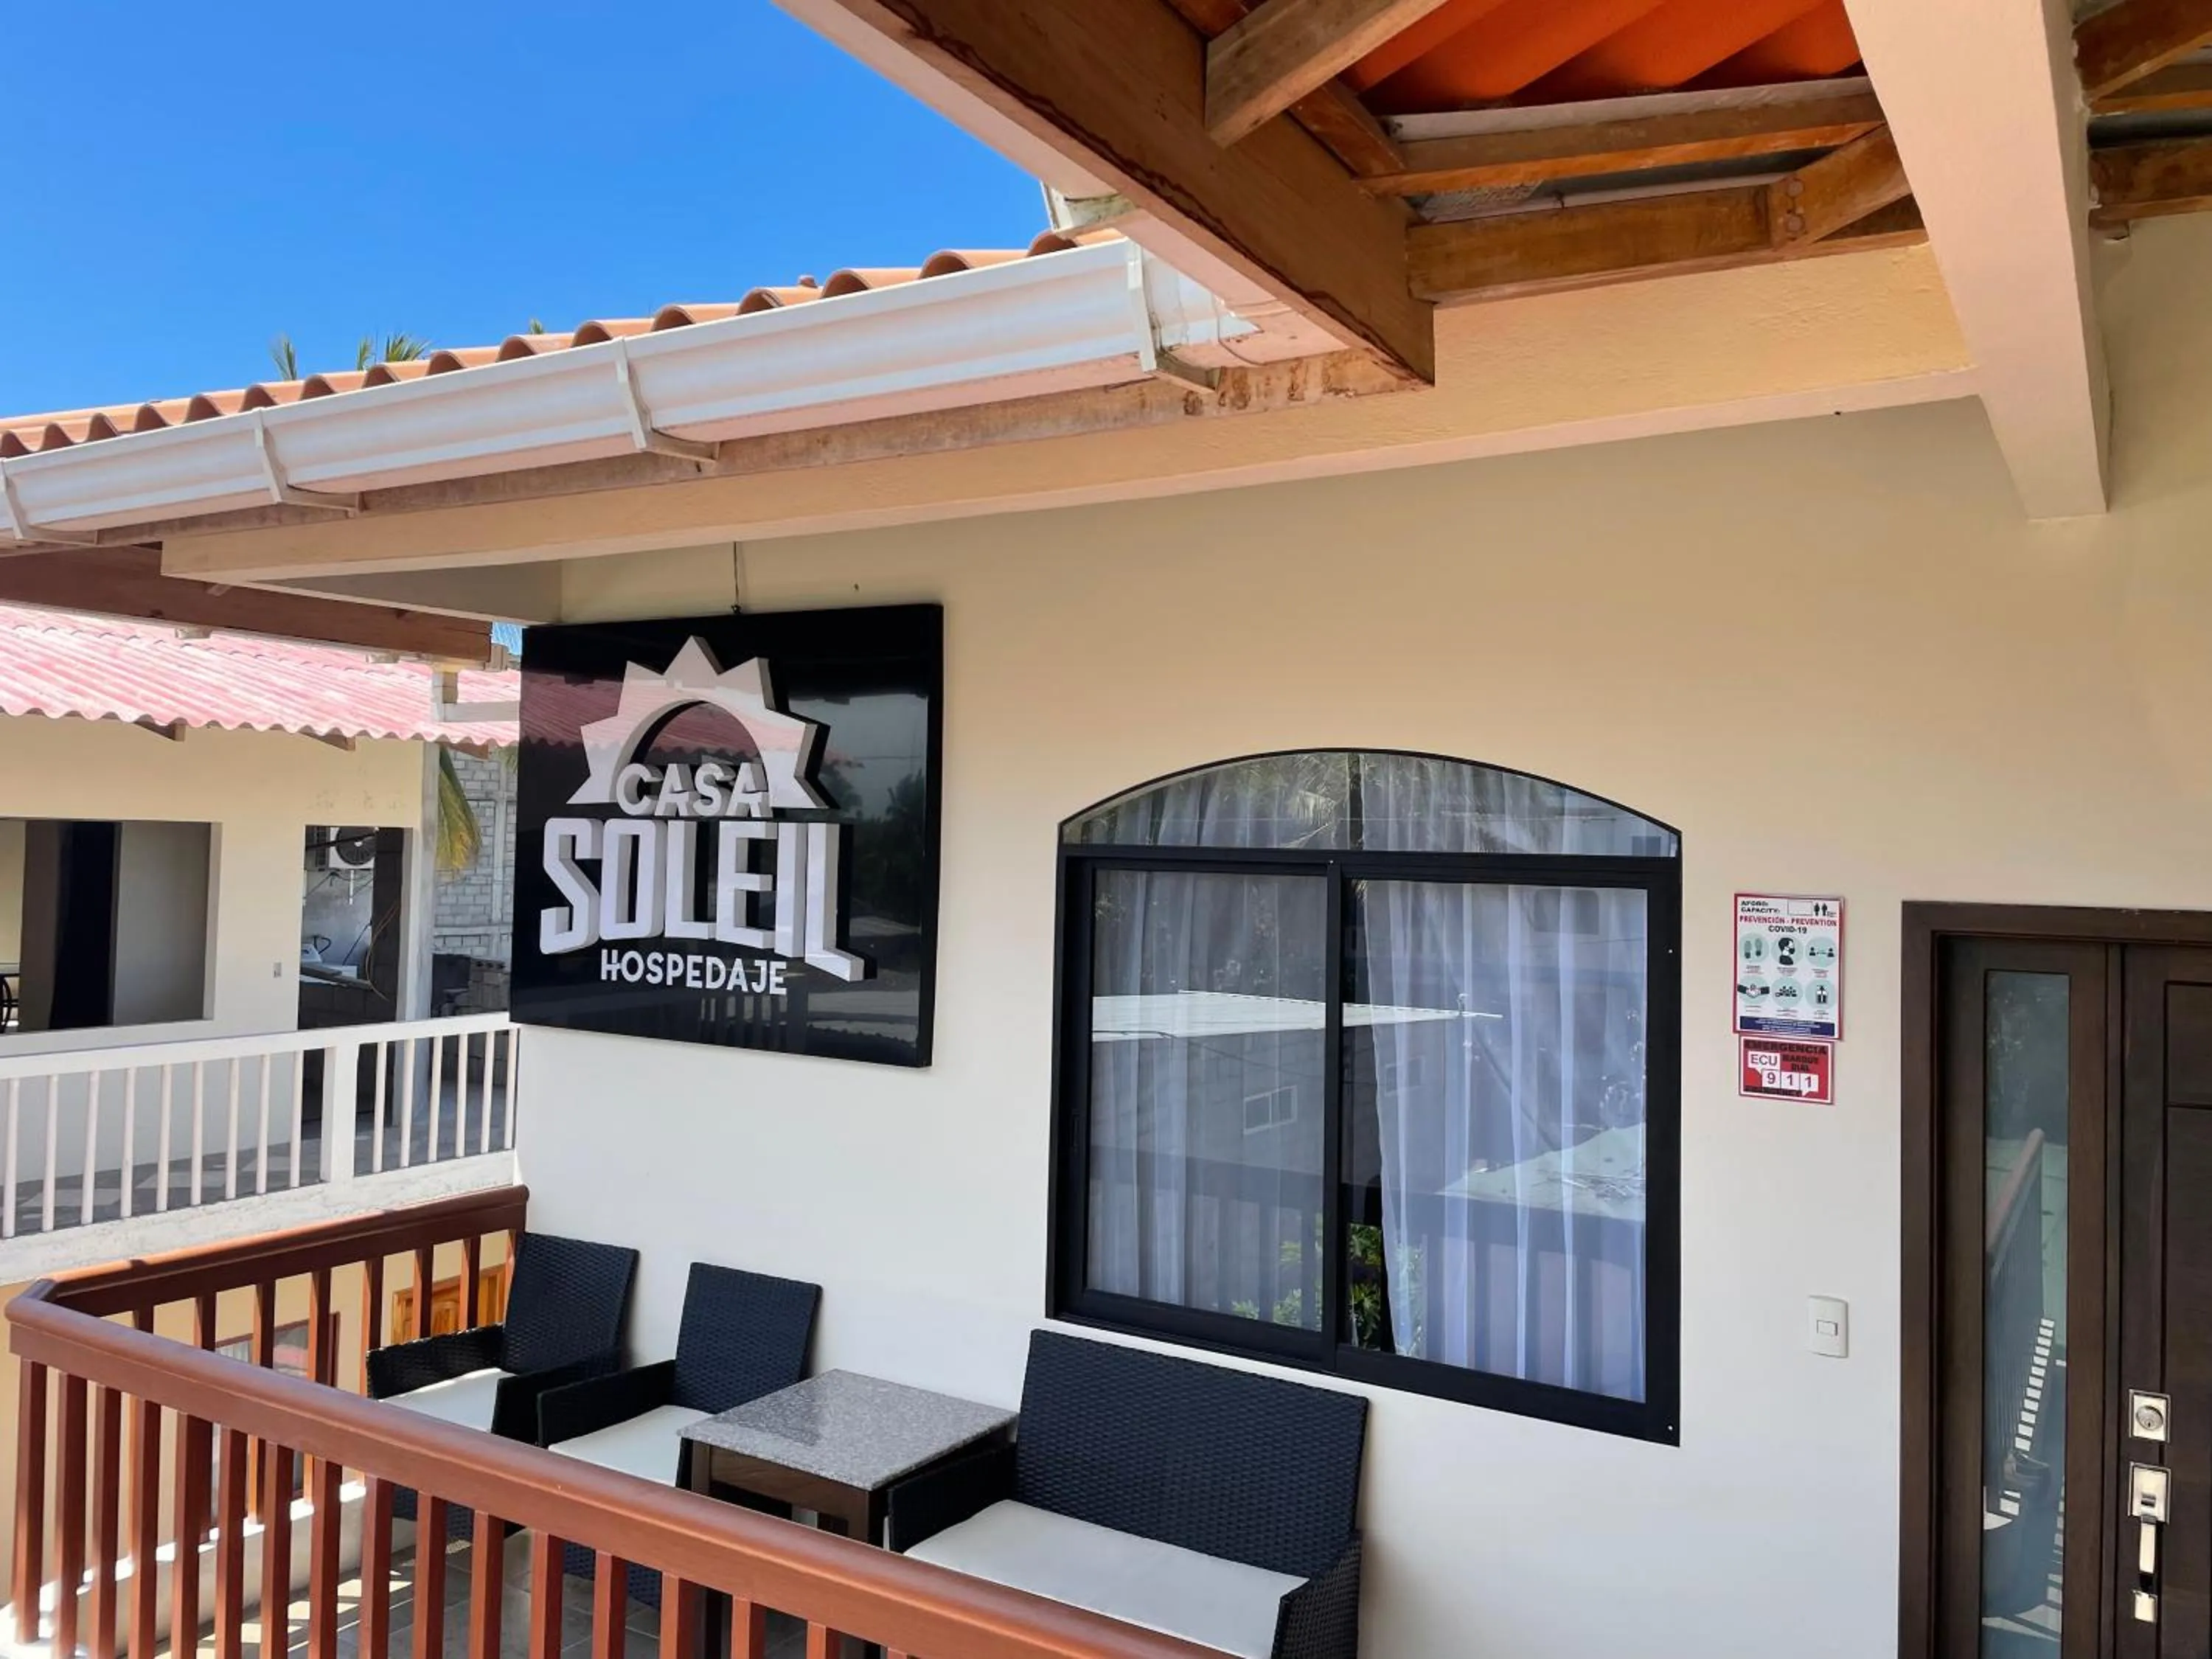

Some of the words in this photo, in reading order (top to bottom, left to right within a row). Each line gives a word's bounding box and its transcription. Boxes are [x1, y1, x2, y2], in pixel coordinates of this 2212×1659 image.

[616, 762, 773, 818] CASA
[540, 818, 864, 982] SOLEIL
[1768, 925, 1808, 934] COVID-19
[1791, 918, 1837, 927] PREVENTION
[600, 948, 787, 995] HOSPEDAJE
[1750, 1054, 1778, 1066] ECU
